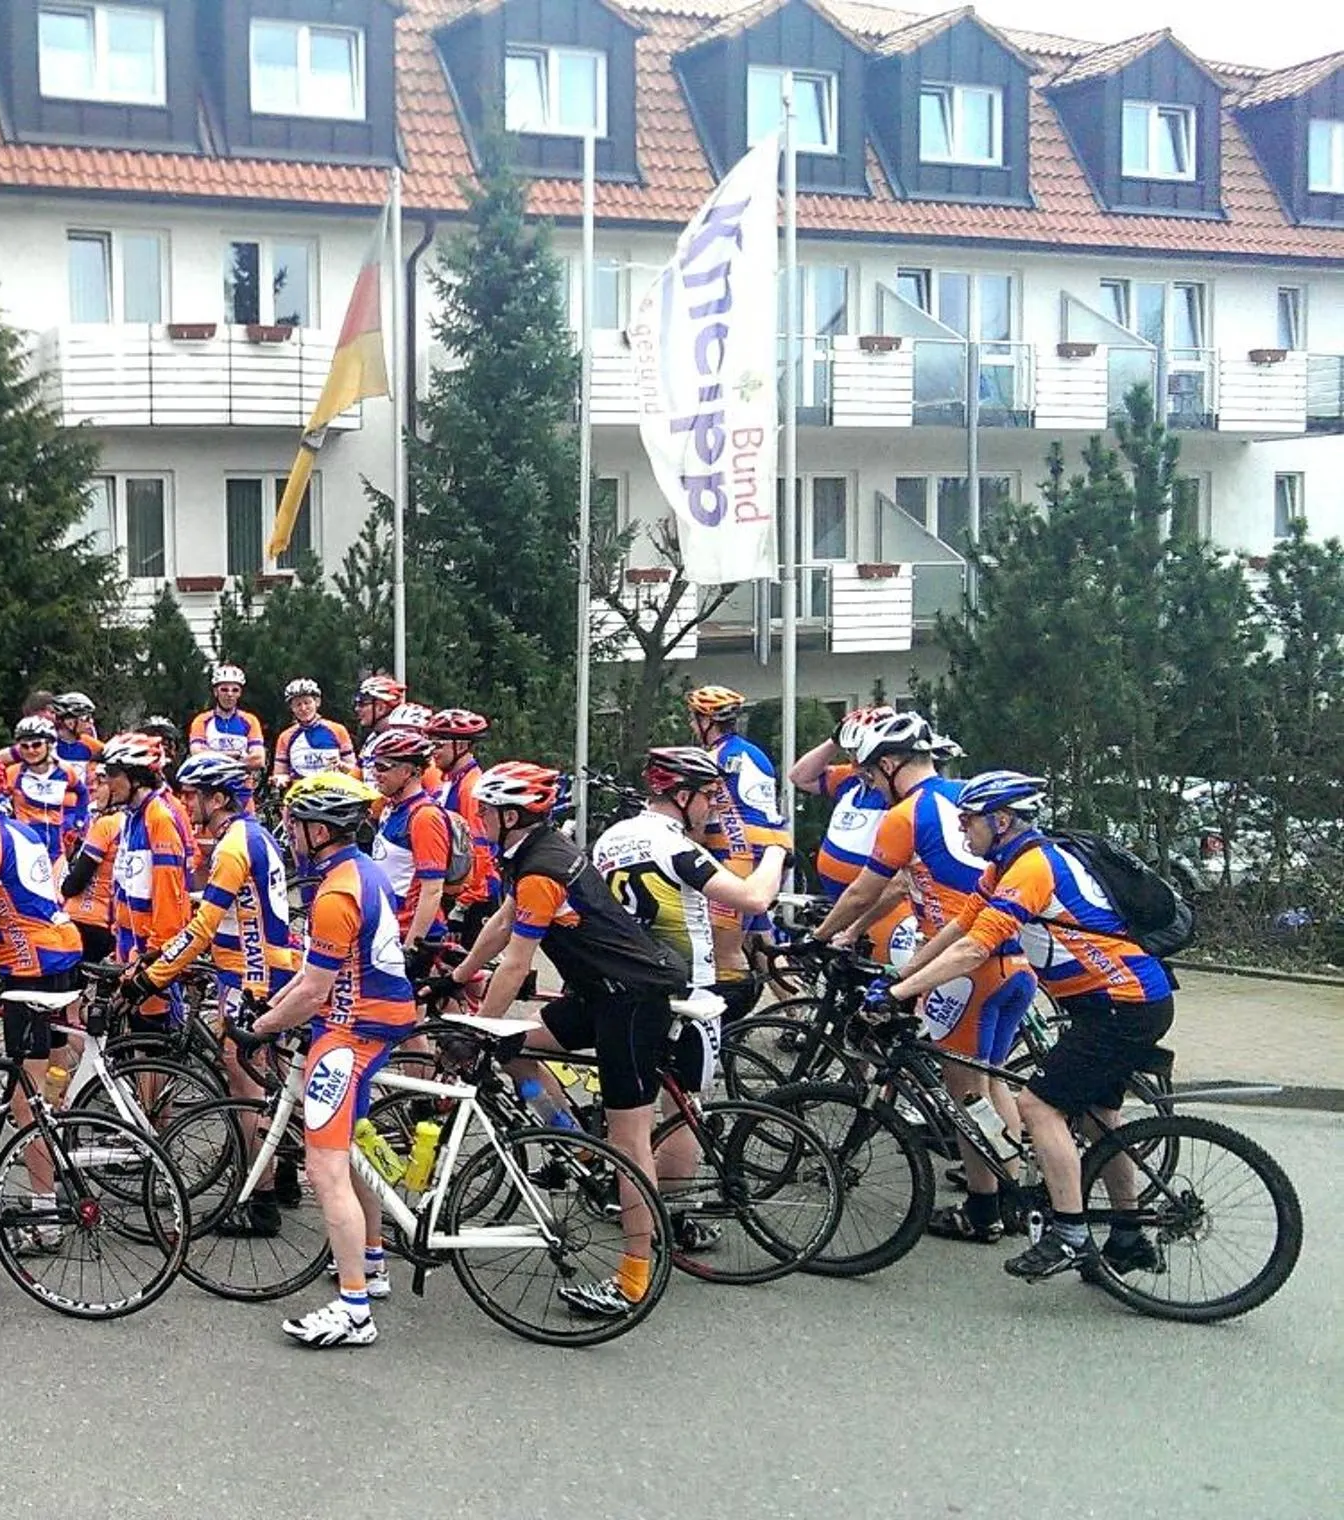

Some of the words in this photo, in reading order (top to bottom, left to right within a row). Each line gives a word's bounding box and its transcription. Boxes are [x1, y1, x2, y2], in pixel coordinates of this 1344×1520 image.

[670, 195, 751, 528] Kneipp
[731, 426, 773, 525] Bund
[720, 808, 747, 853] TRAVE
[238, 885, 256, 911] RV
[9, 922, 33, 969] TRAVE
[242, 917, 265, 982] TRAVE
[892, 925, 908, 950] RV
[925, 988, 945, 1021] RV
[936, 995, 960, 1026] TRAVE
[307, 1060, 332, 1102] RV
[318, 1067, 346, 1105] TRAVE
